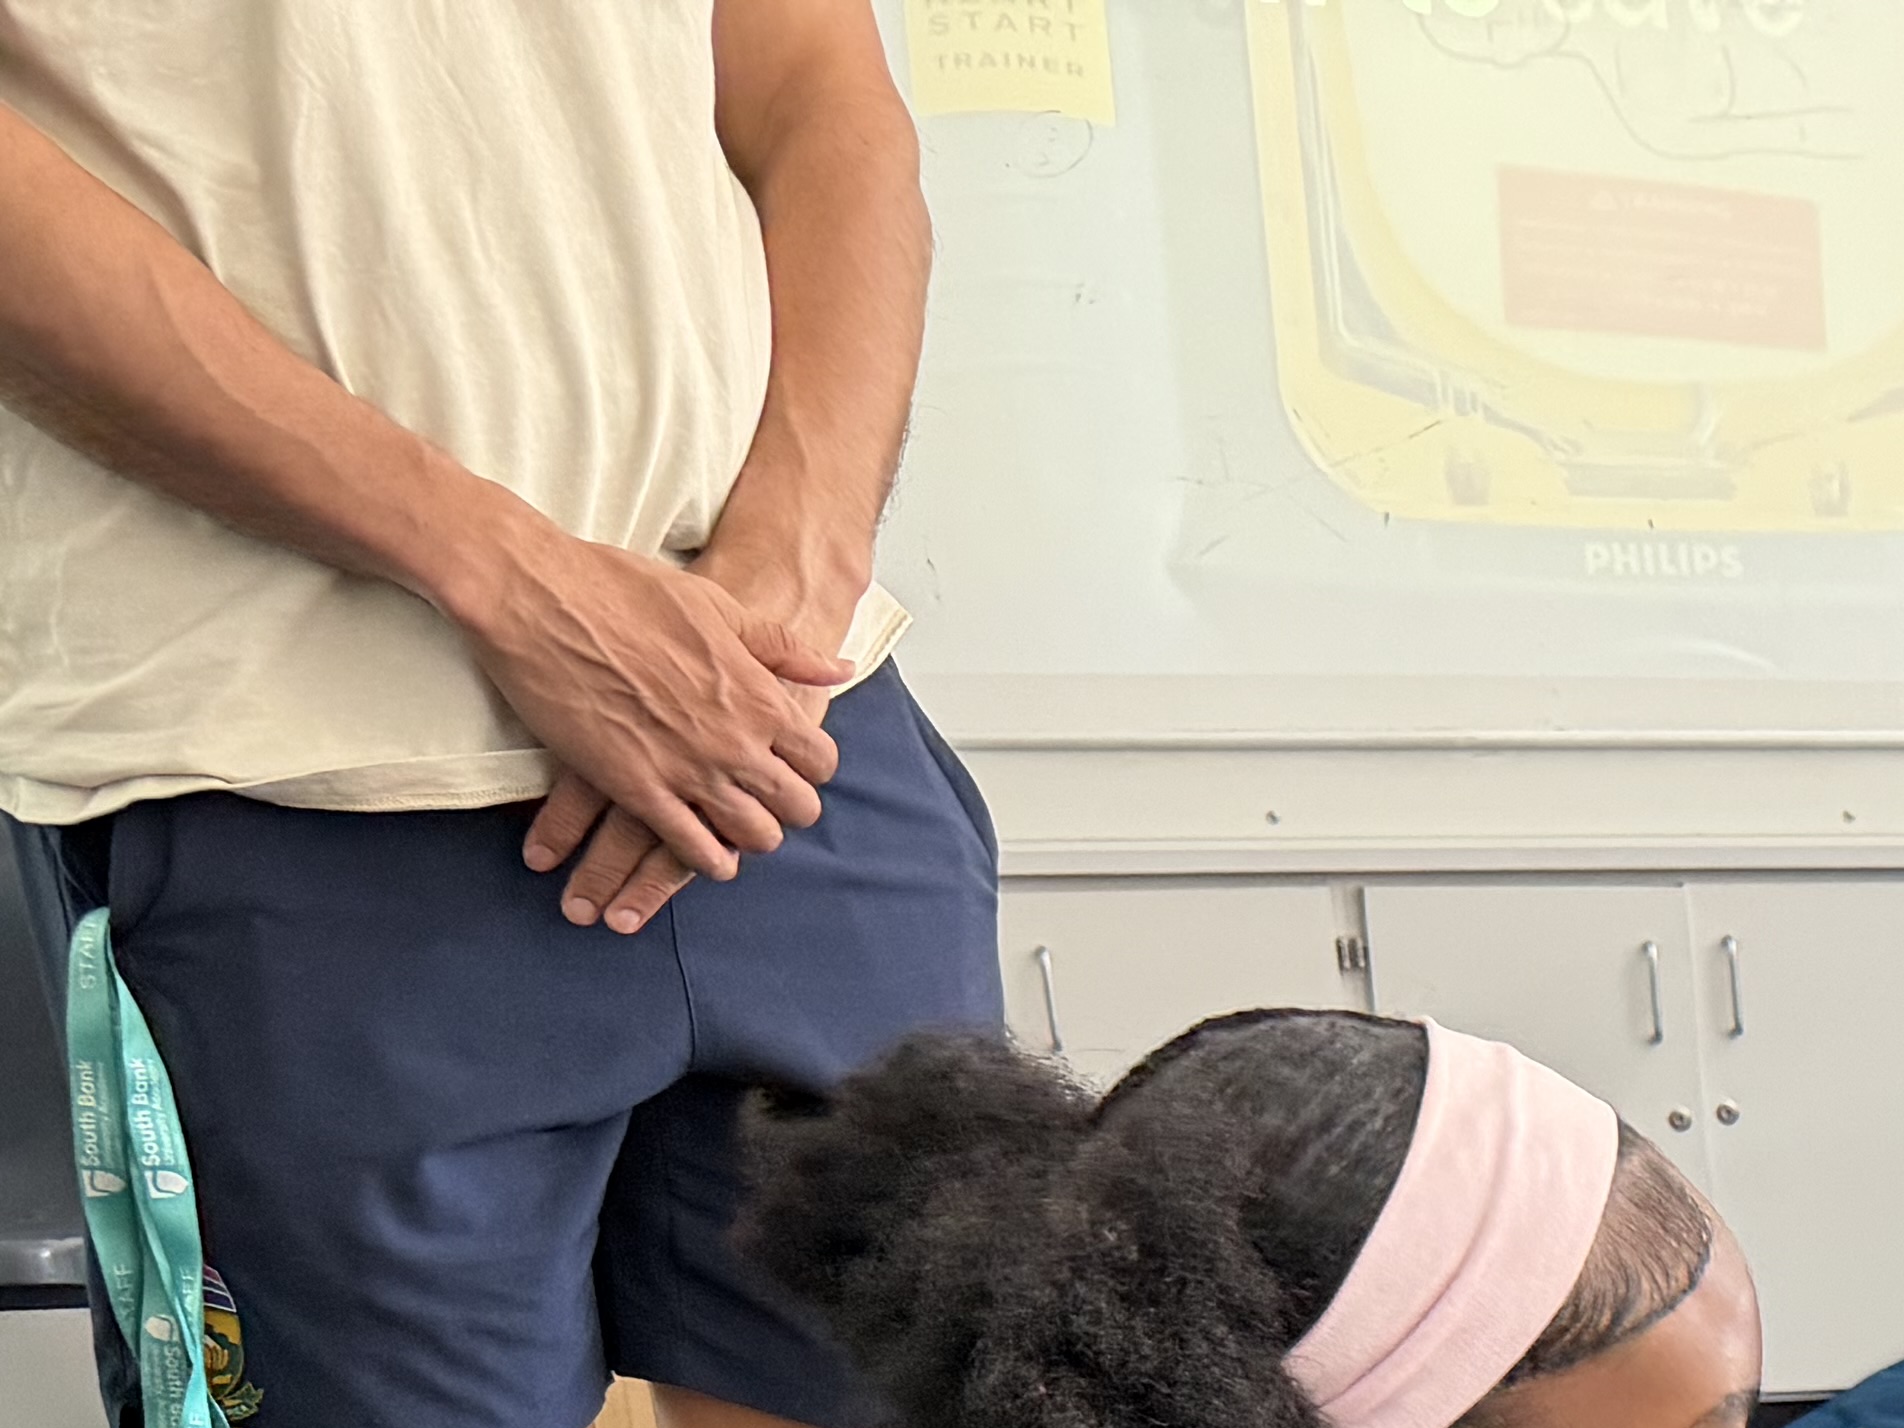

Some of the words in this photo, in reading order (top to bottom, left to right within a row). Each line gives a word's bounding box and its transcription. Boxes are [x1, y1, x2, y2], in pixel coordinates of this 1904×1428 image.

[927, 11, 1084, 42] START
[931, 51, 1084, 78] TRAINER
[1584, 541, 1744, 578] PHILIPS
[75, 1060, 97, 1107] Bank
[129, 1058, 151, 1105] Bank
[79, 1111, 100, 1166] South
[133, 1110, 161, 1166] South
